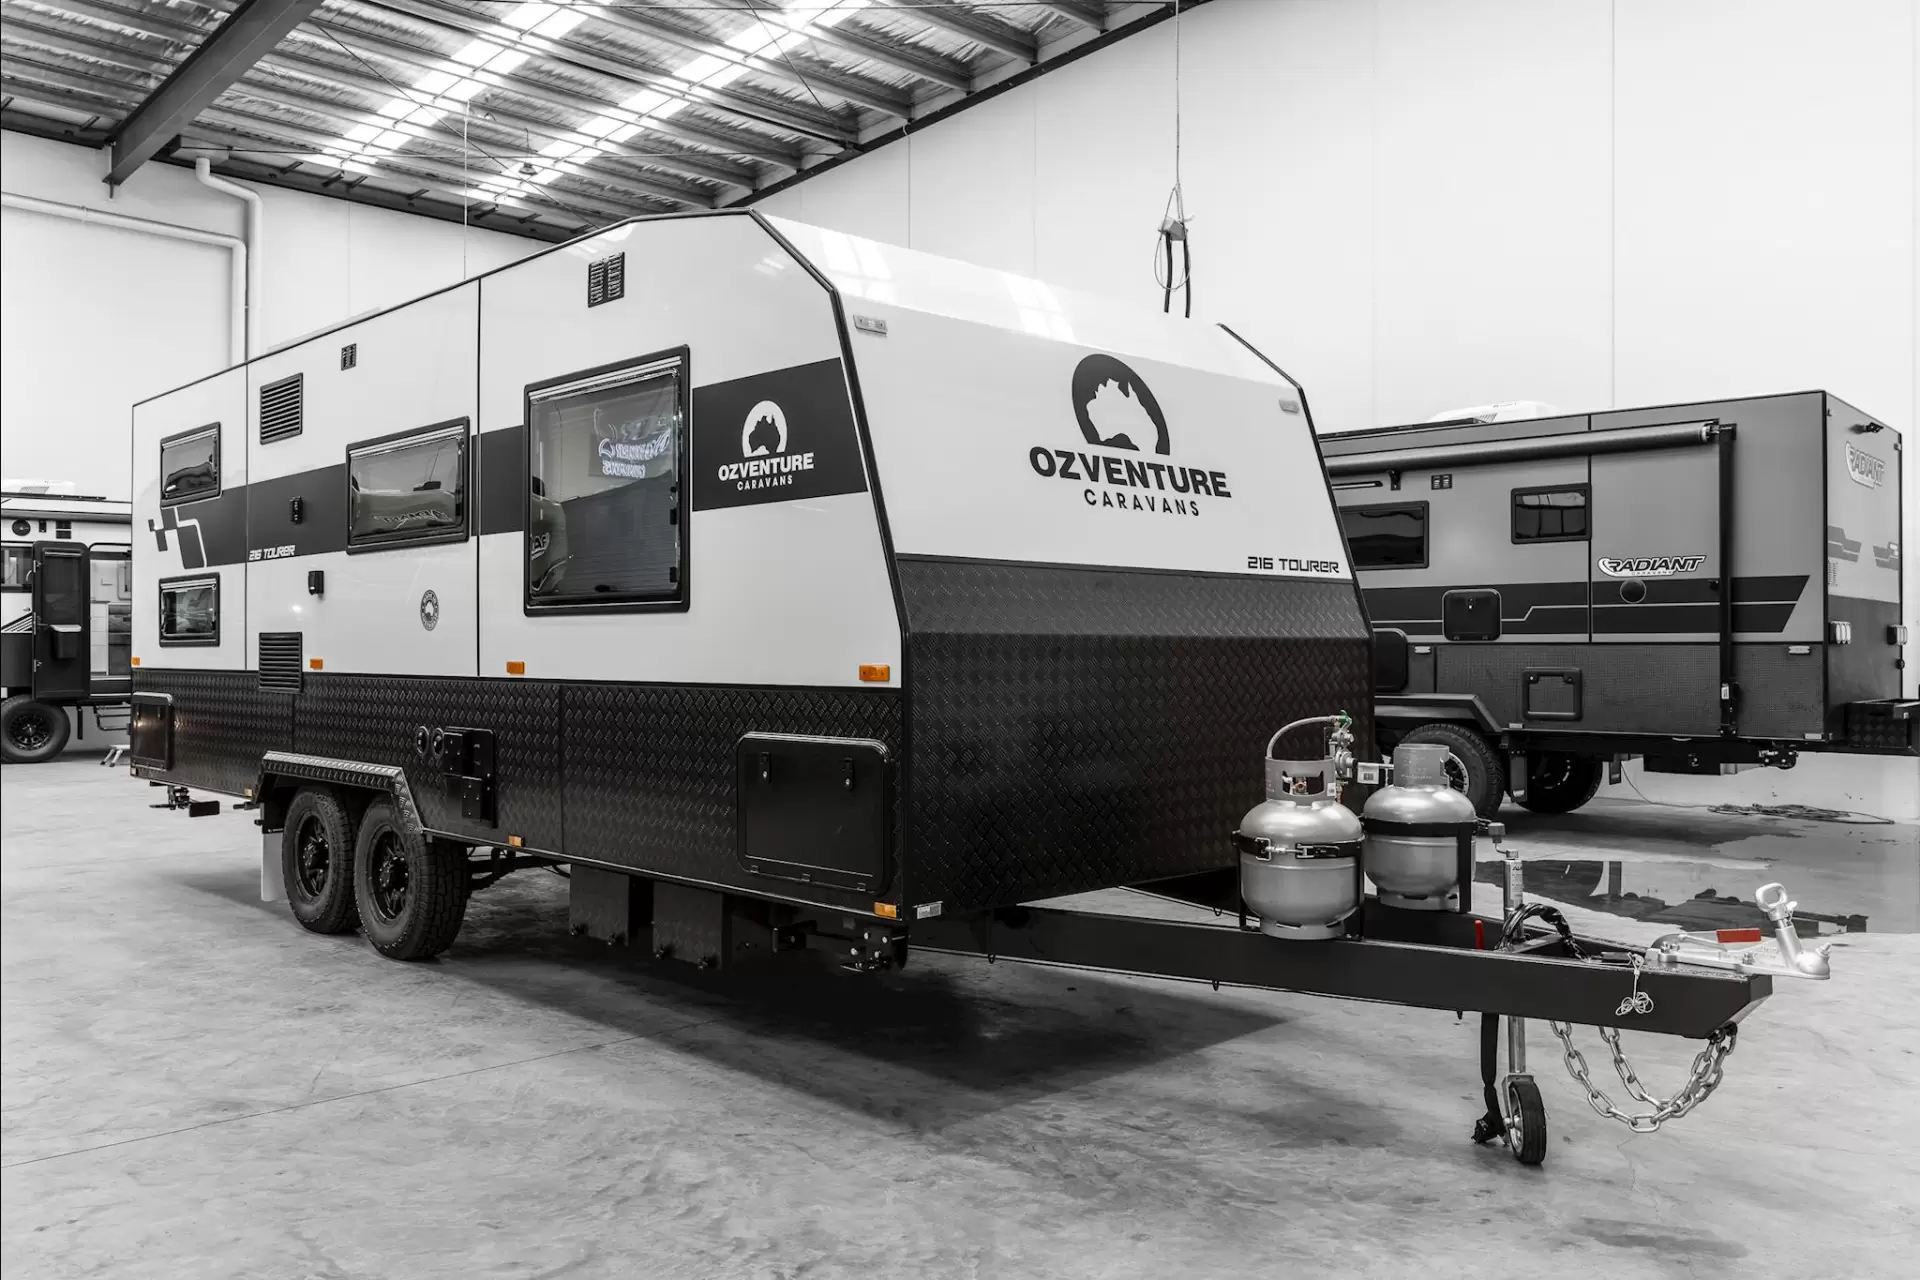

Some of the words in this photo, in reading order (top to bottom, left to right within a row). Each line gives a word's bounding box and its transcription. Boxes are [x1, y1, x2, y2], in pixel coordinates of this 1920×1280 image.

[718, 452, 814, 481] OZVENTURE
[1029, 446, 1232, 498] OZVENTURE
[1847, 444, 1885, 485] RADIANT
[737, 475, 793, 491] CARAVANS
[1084, 488, 1200, 517] CARAVANS
[263, 544, 296, 559] TOURER
[1247, 556, 1274, 570] 216
[1279, 558, 1340, 573] TOURER
[1603, 556, 1705, 572] RADIANT
